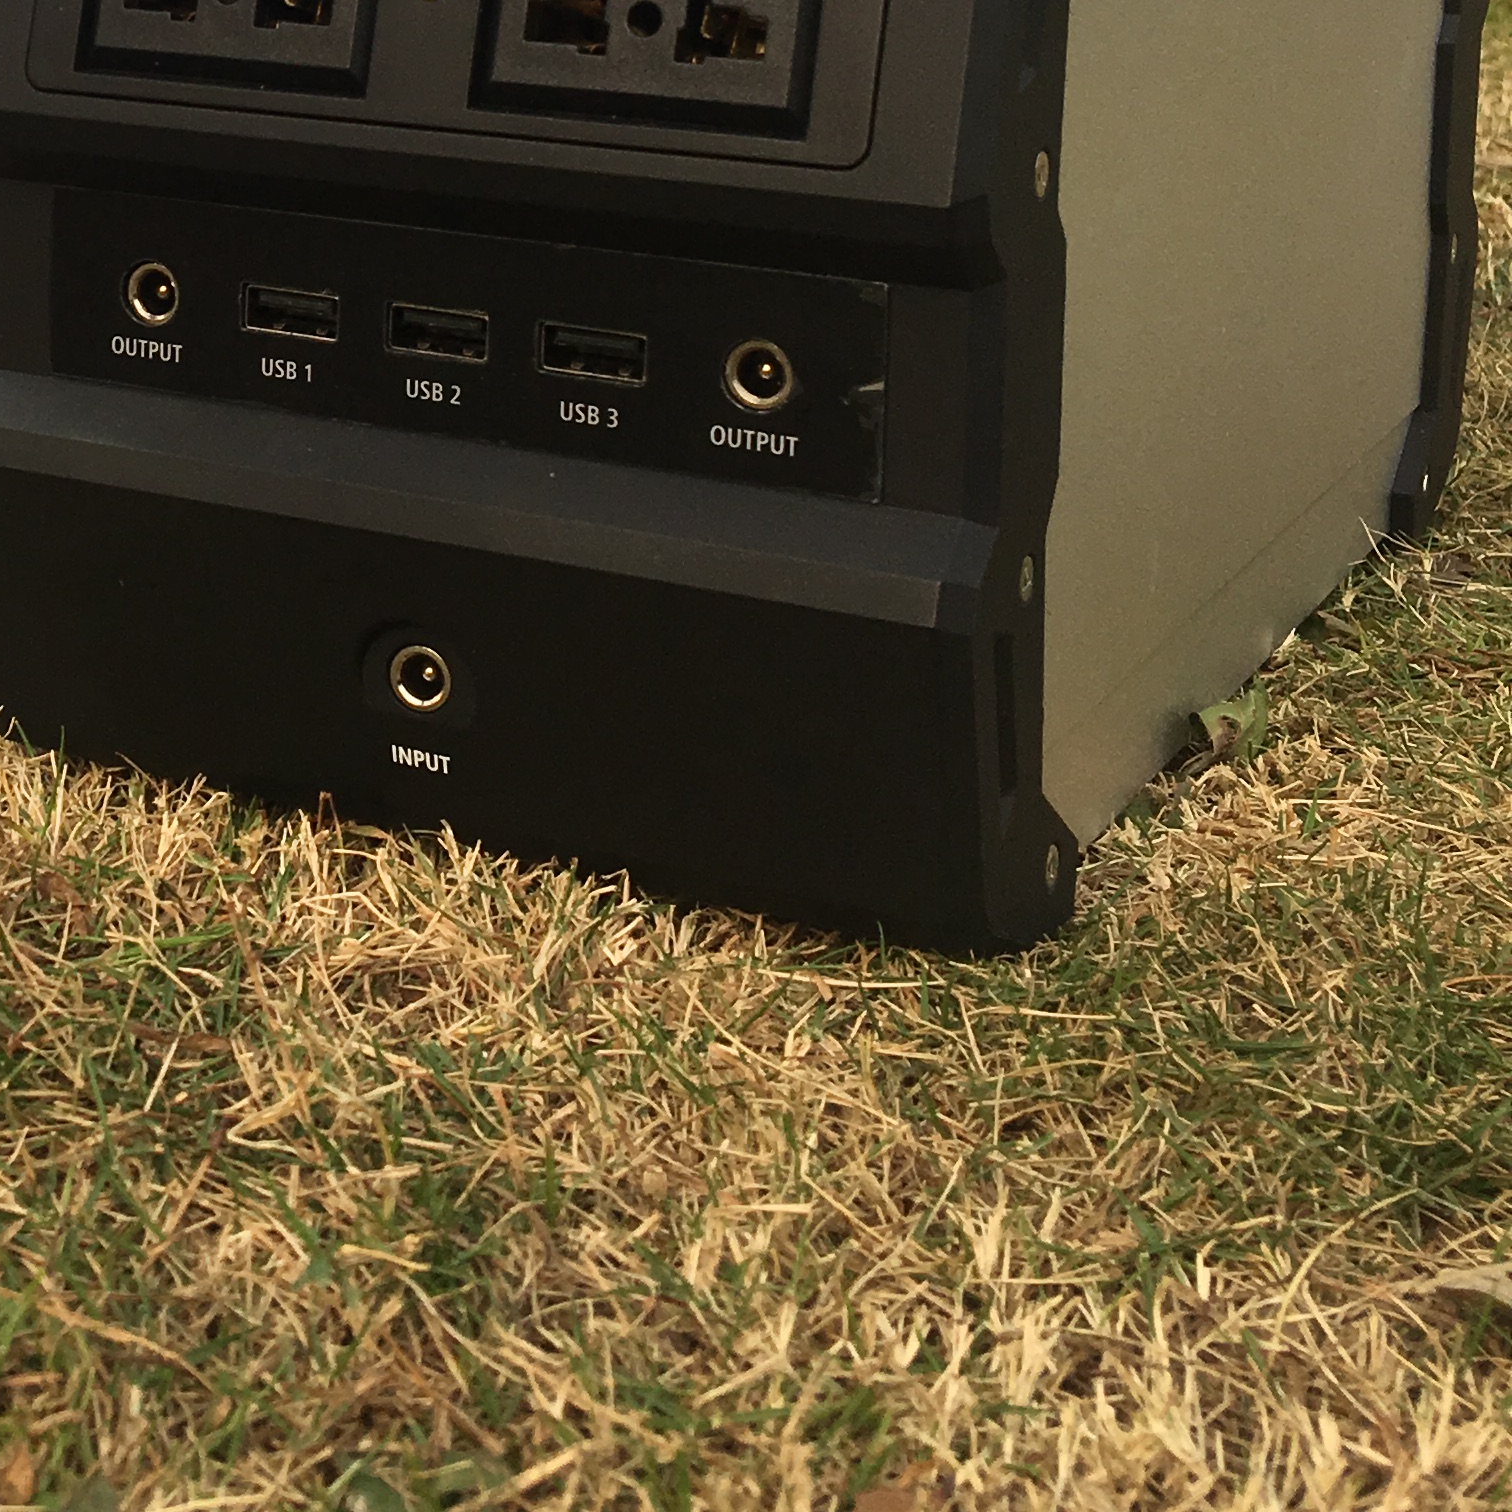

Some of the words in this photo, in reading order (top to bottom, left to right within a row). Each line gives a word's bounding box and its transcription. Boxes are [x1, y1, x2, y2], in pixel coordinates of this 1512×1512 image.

[111, 335, 183, 364] OUTPUT
[261, 357, 297, 380] USB
[304, 363, 313, 383] 1
[406, 378, 443, 402] USB
[449, 385, 461, 405] 2
[560, 400, 600, 425] USB
[606, 407, 619, 428] 3
[710, 425, 799, 457] OUTPUT
[391, 744, 451, 775] INPUT
